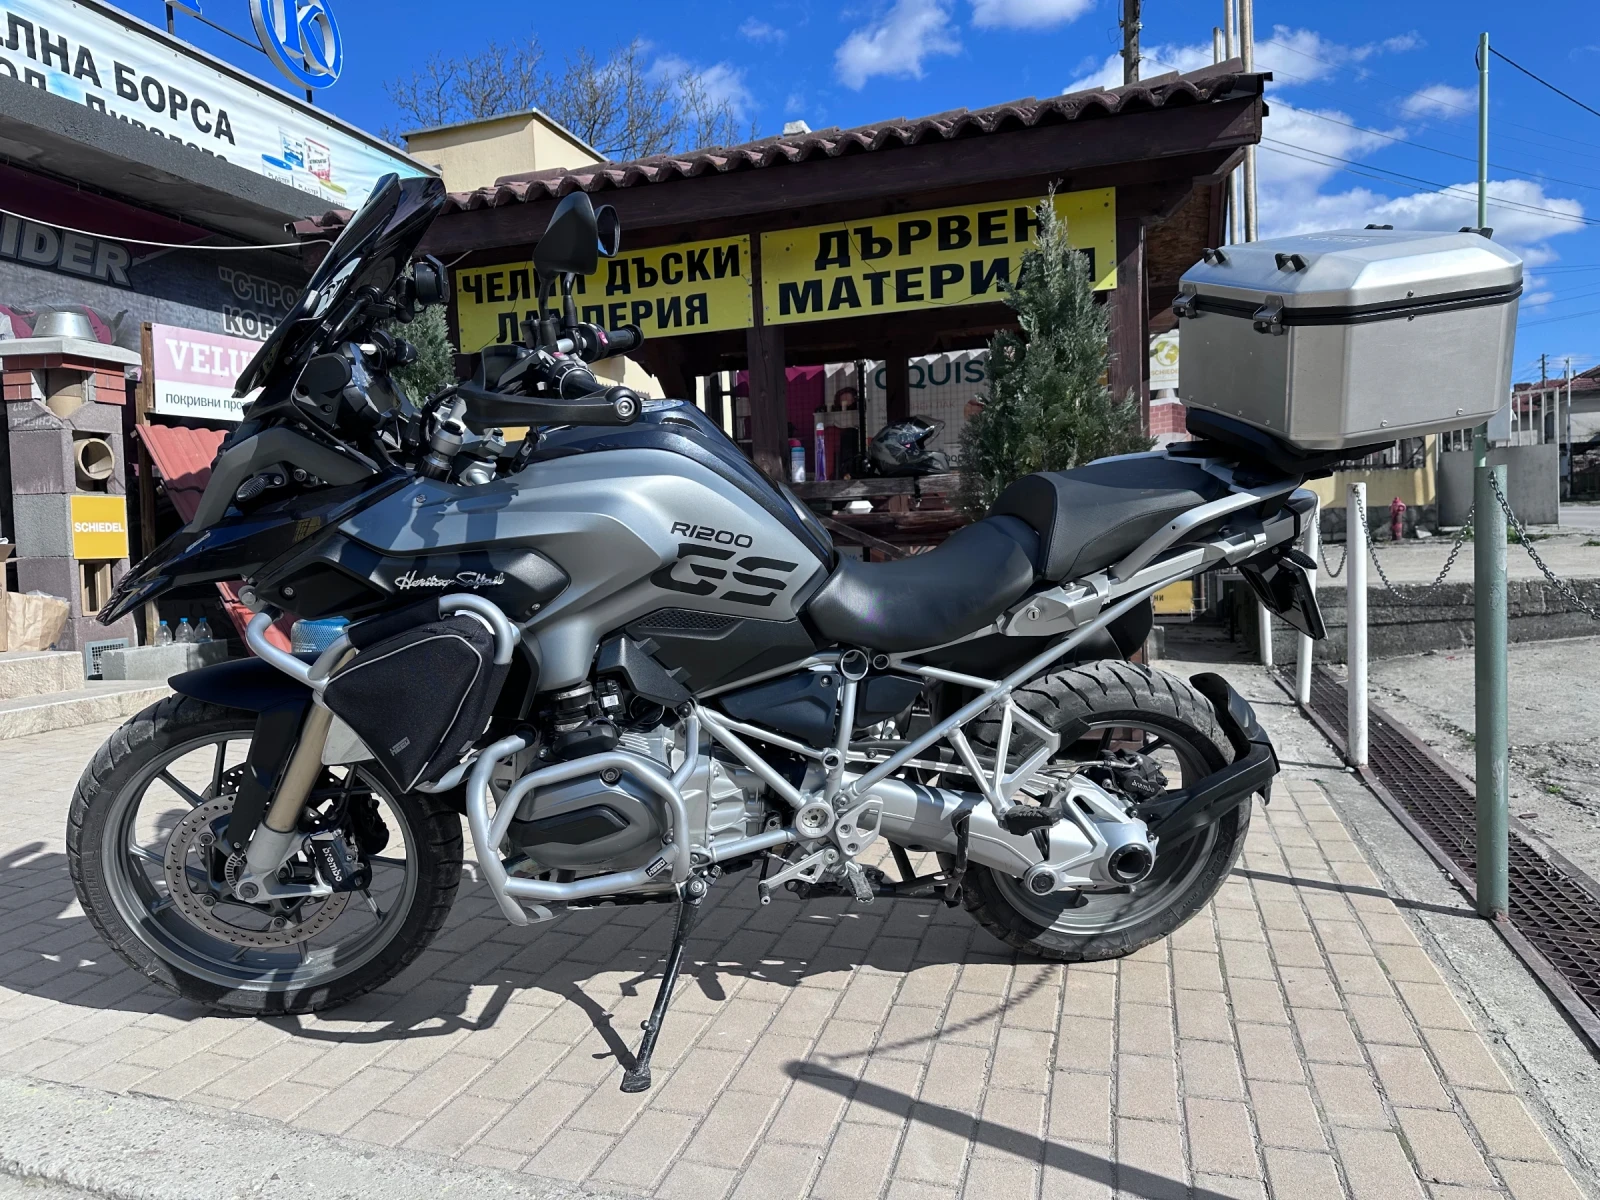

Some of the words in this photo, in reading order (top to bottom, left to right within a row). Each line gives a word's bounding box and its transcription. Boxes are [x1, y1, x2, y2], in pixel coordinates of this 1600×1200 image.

[0, 11, 103, 89] ЛНА
[114, 60, 236, 147] БОРСА
[815, 206, 1044, 271] ДЪРВЕН
[605, 244, 740, 296] ДЪСКИ
[165, 338, 254, 378] VELU
[165, 393, 221, 409] покривни
[223, 399, 246, 413] про
[74, 521, 125, 533] SCHIEDEL
[670, 521, 753, 549] R1200
[650, 543, 799, 607] GS
[321, 846, 343, 882] brembo
